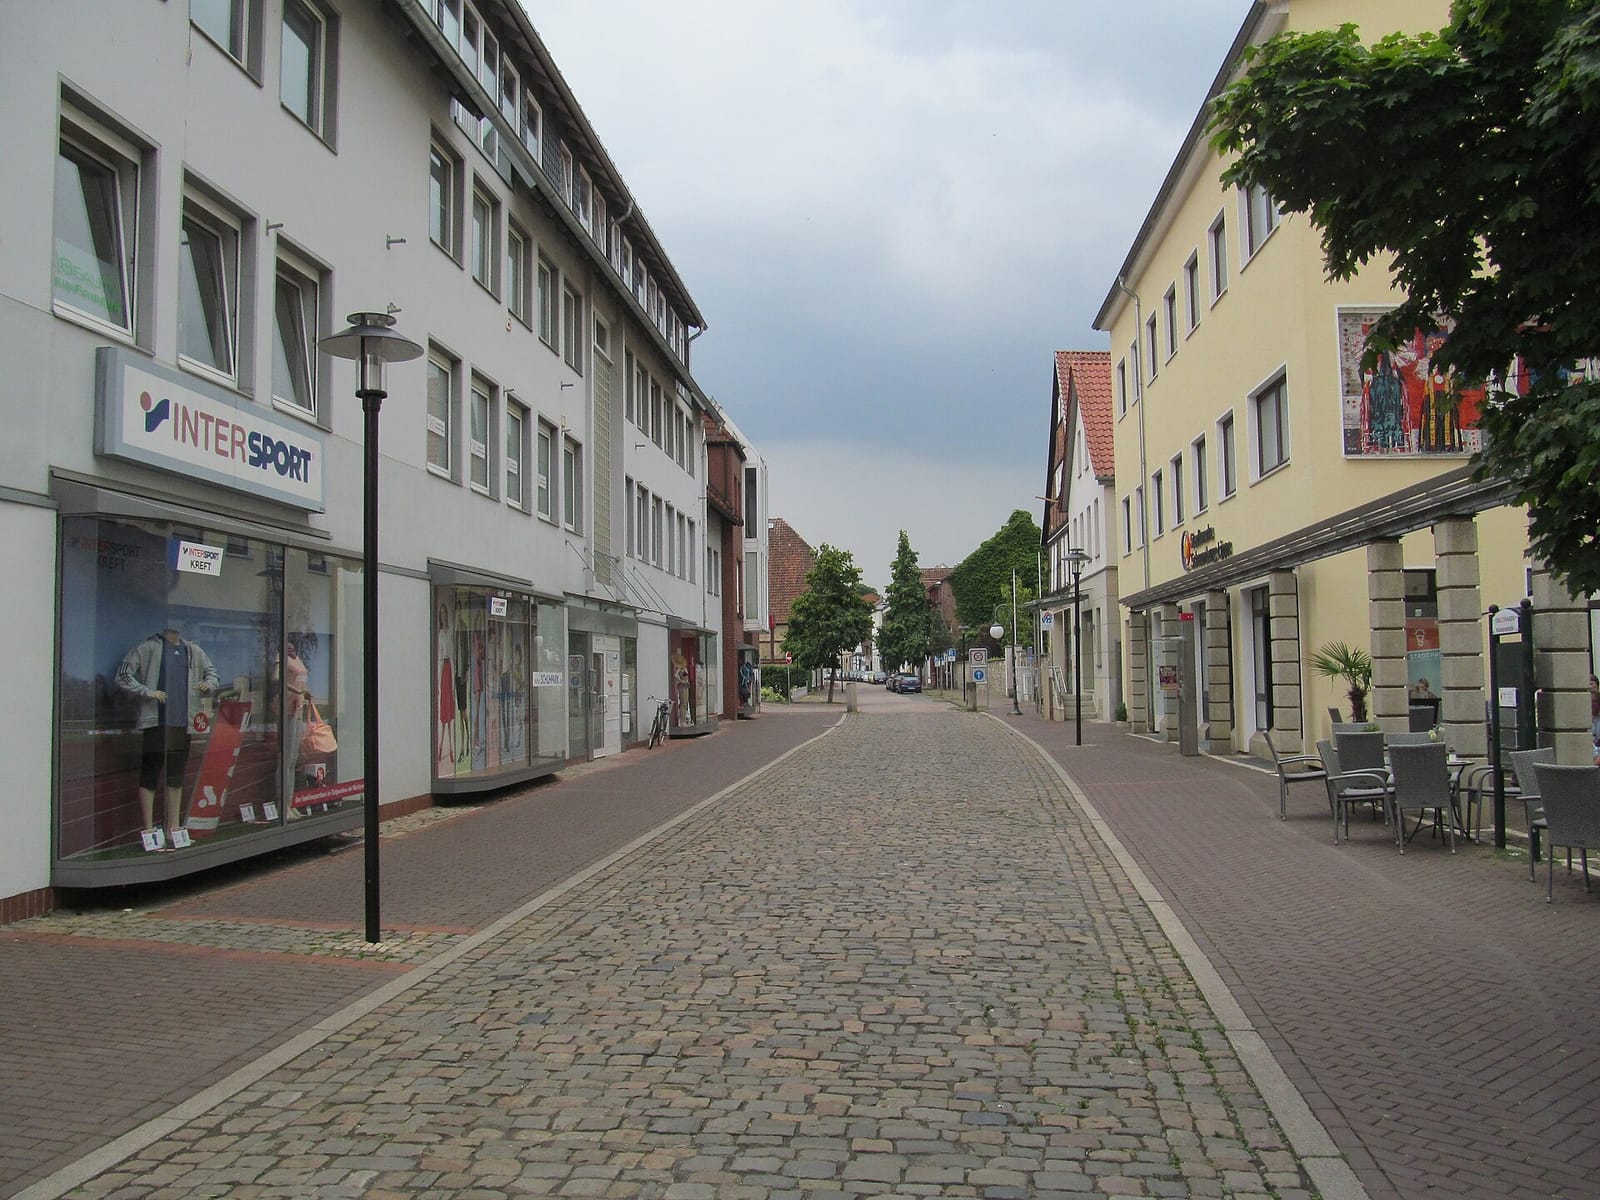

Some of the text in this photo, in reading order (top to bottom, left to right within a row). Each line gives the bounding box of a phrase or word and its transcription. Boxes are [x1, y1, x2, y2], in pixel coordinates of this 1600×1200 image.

[173, 402, 312, 483] INTERSPORT
[188, 547, 220, 560] INTERSPORT
[190, 560, 212, 571] KREFT
